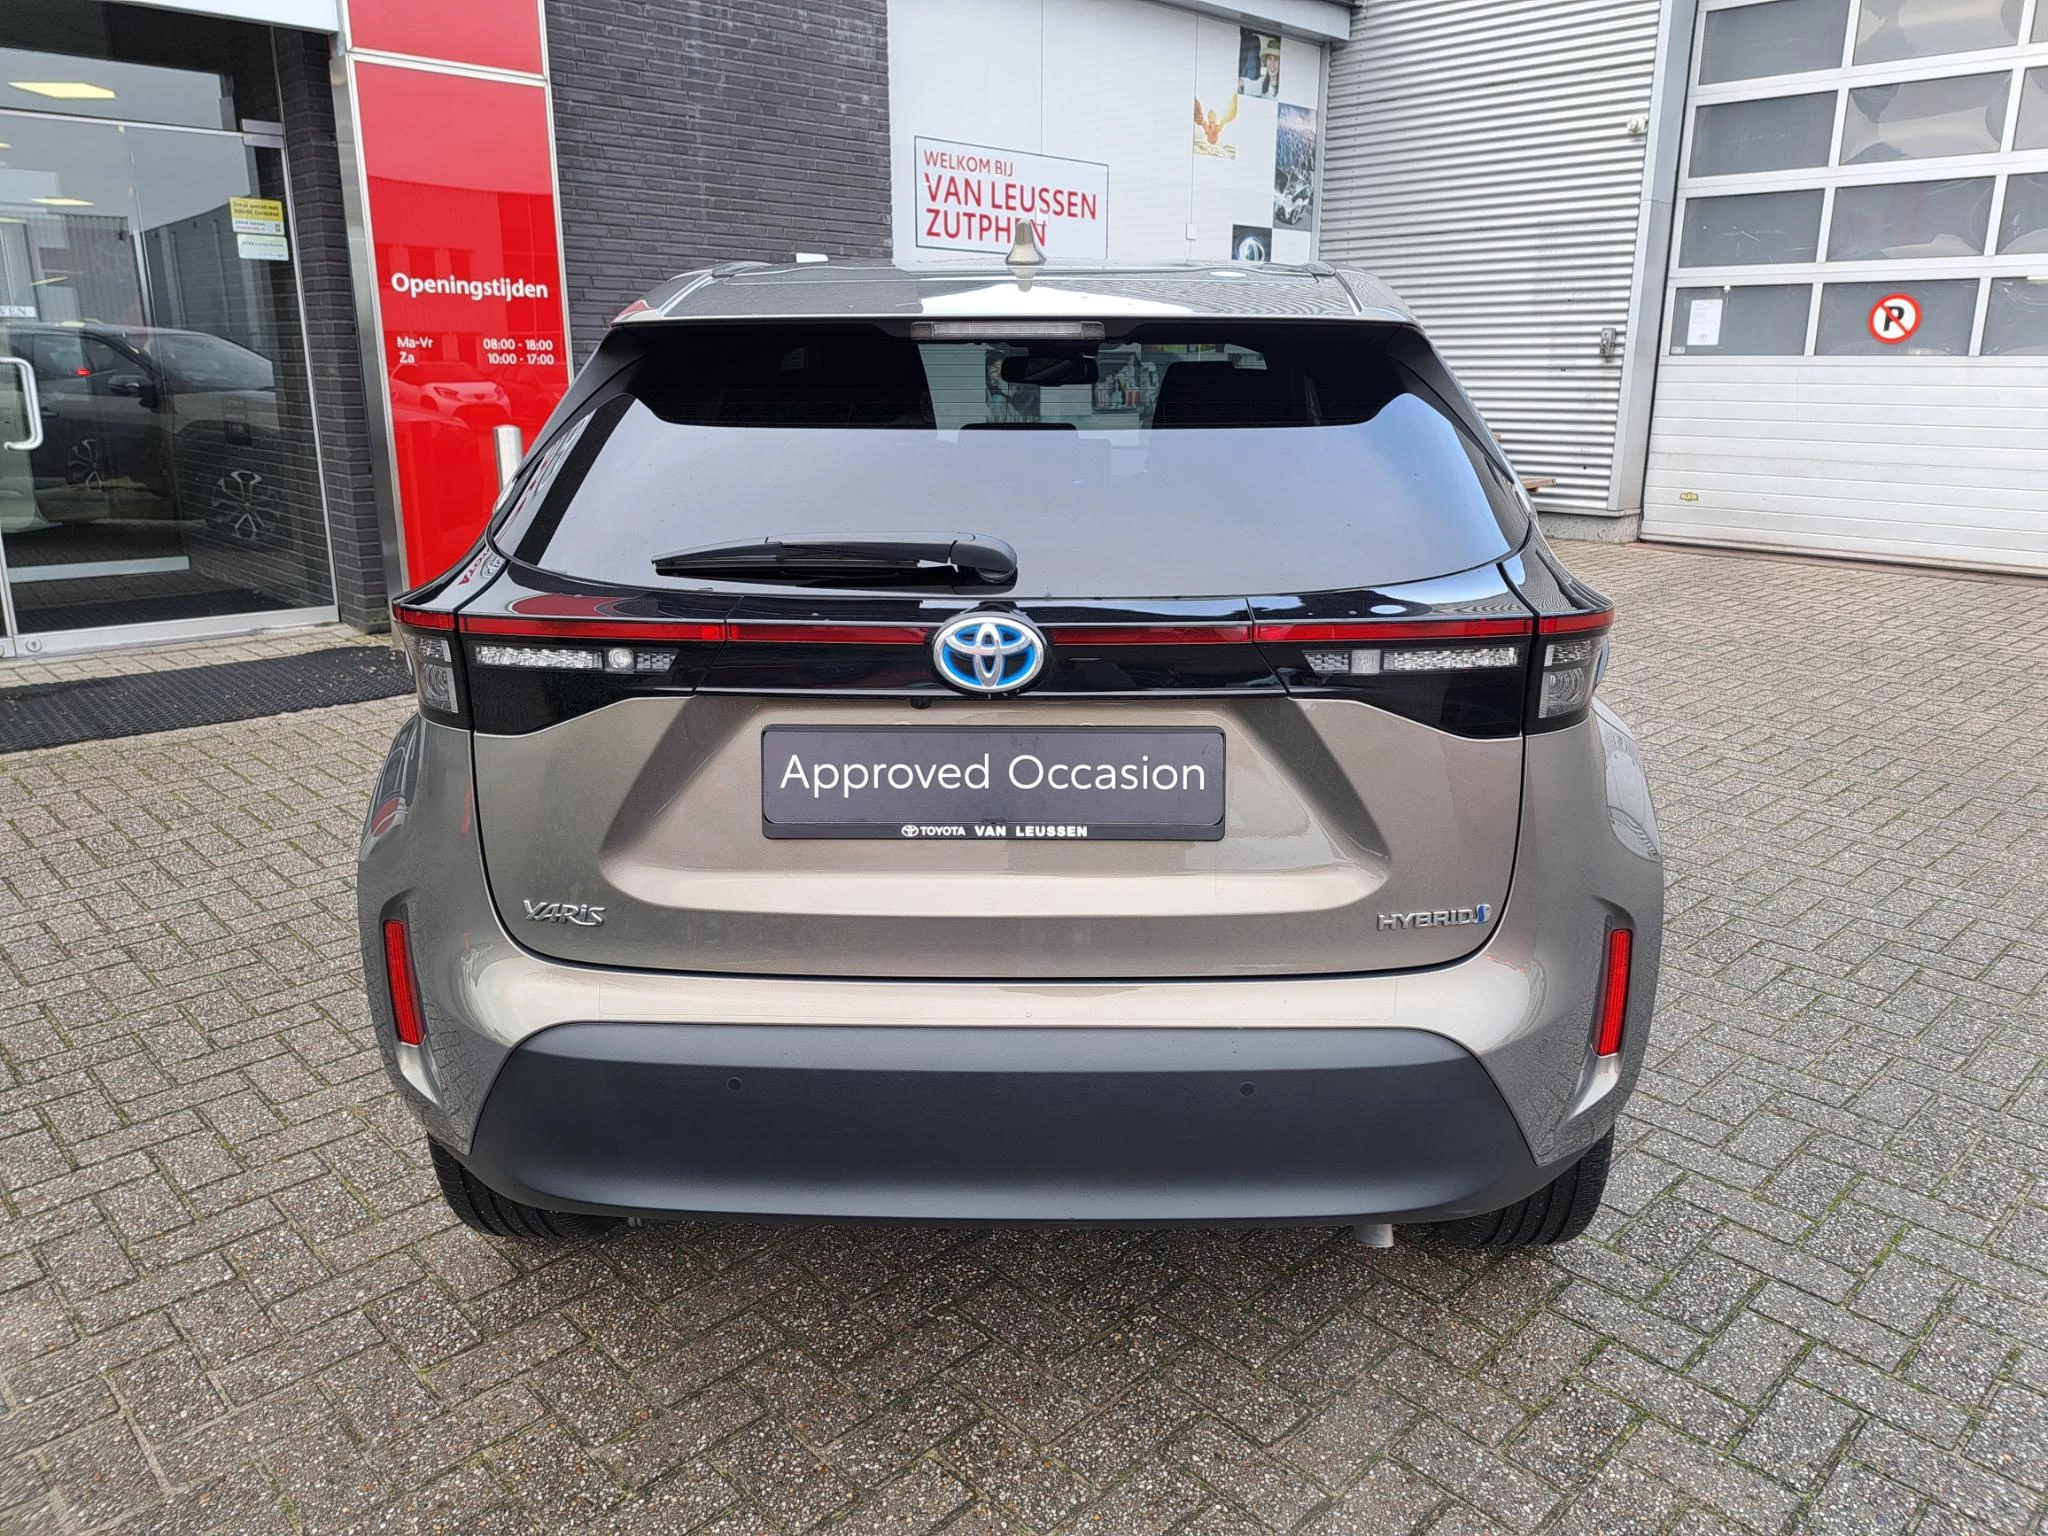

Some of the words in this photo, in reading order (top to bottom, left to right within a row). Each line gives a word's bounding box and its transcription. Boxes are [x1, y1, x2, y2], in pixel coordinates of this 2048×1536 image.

[924, 150, 991, 174] WELKOM
[995, 160, 1014, 177] BIJ
[924, 172, 982, 207] VAN
[991, 181, 1097, 220] LEUSSEN
[926, 208, 1046, 246] ZUTPHN
[391, 272, 549, 302] Openingstijden
[397, 336, 433, 349] Ma-Vr
[483, 338, 515, 350] 08:00
[525, 339, 553, 351] 18:00
[400, 351, 415, 364] Za
[488, 353, 517, 365] 10:00
[527, 353, 555, 366] 17:00
[780, 753, 990, 799] Approved
[1008, 754, 1206, 791] Occasion
[920, 825, 967, 837] TOYOTA
[974, 825, 1007, 837] VAN
[1015, 825, 1088, 838] LEUSSEN
[1377, 908, 1474, 931] HYBRID
